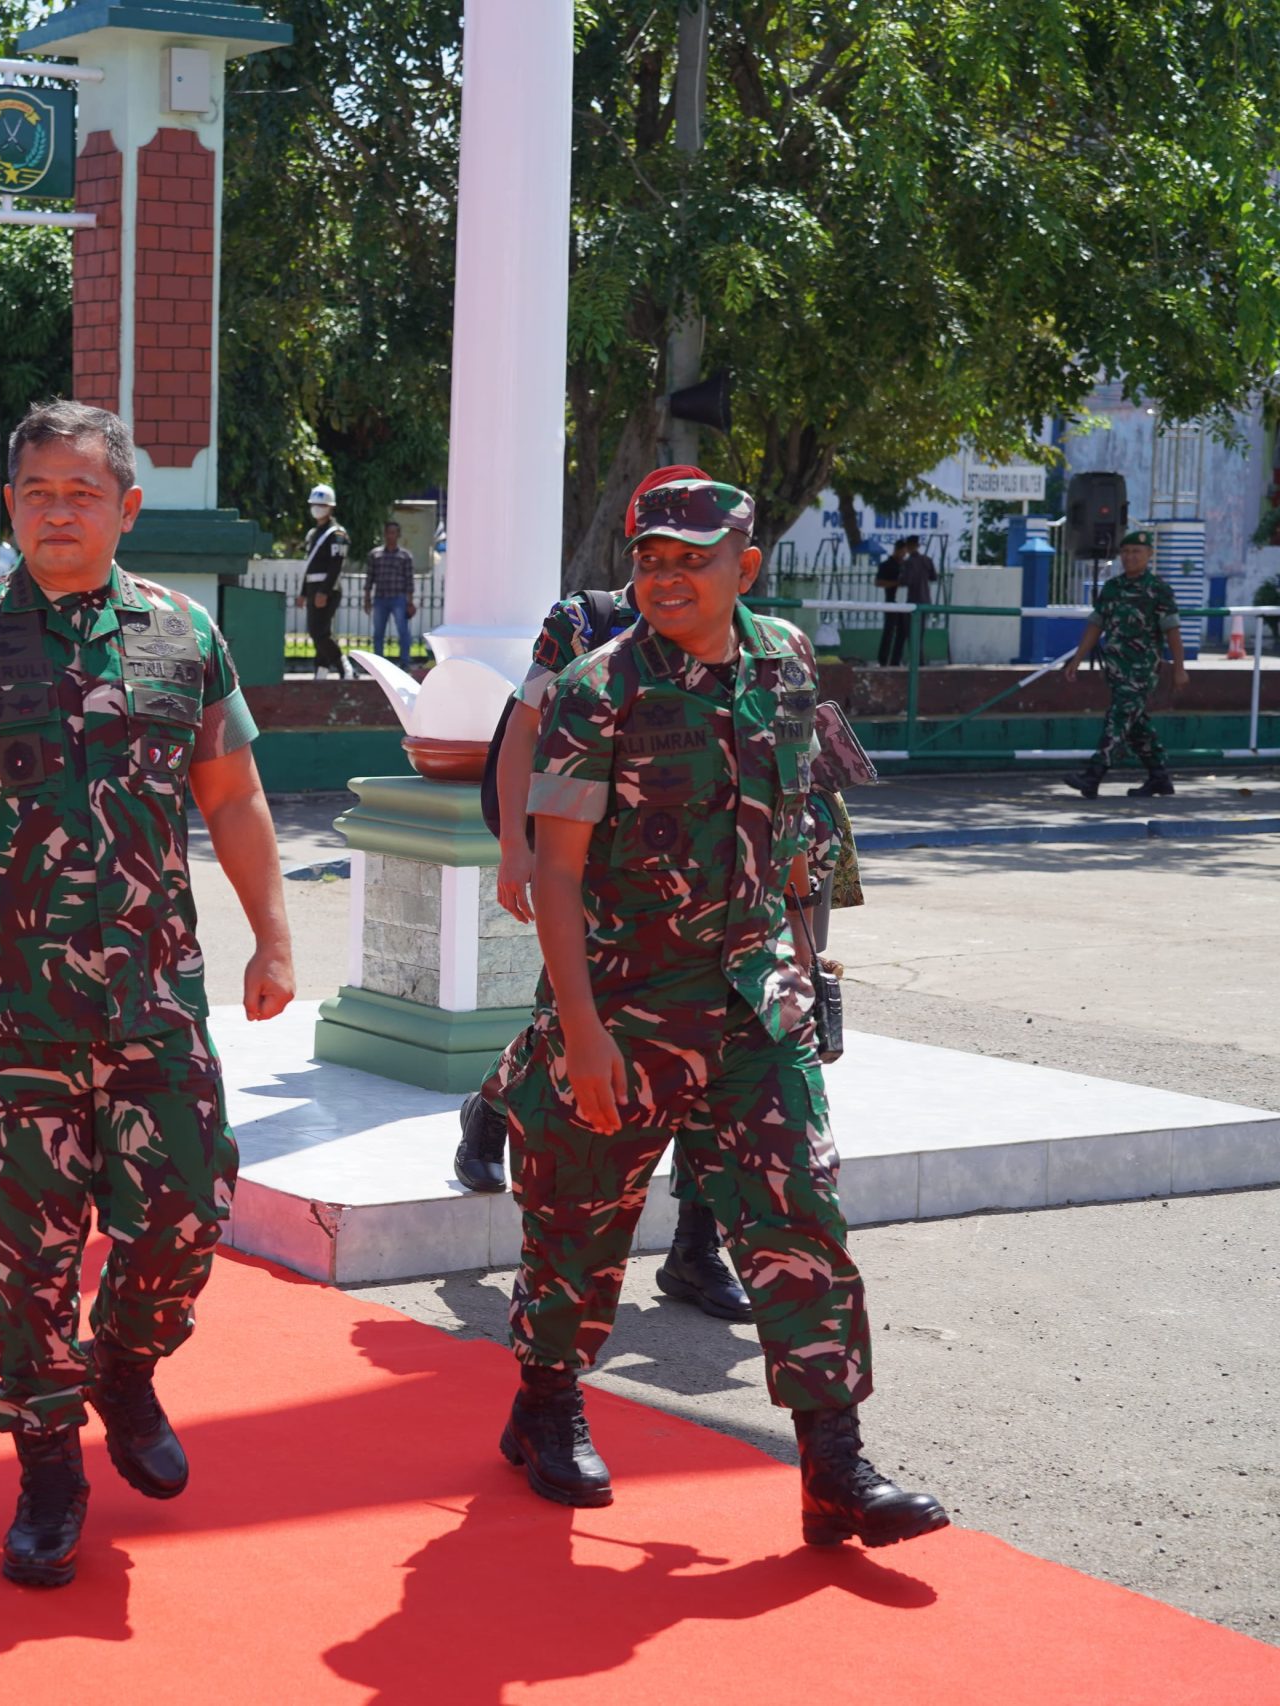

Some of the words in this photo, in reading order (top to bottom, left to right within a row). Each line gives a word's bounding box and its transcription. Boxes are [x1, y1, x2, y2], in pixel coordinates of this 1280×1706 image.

[128, 660, 165, 678] TNI
[172, 662, 197, 681] AD
[777, 720, 804, 738] TNI
[649, 729, 707, 752] IMRAN
